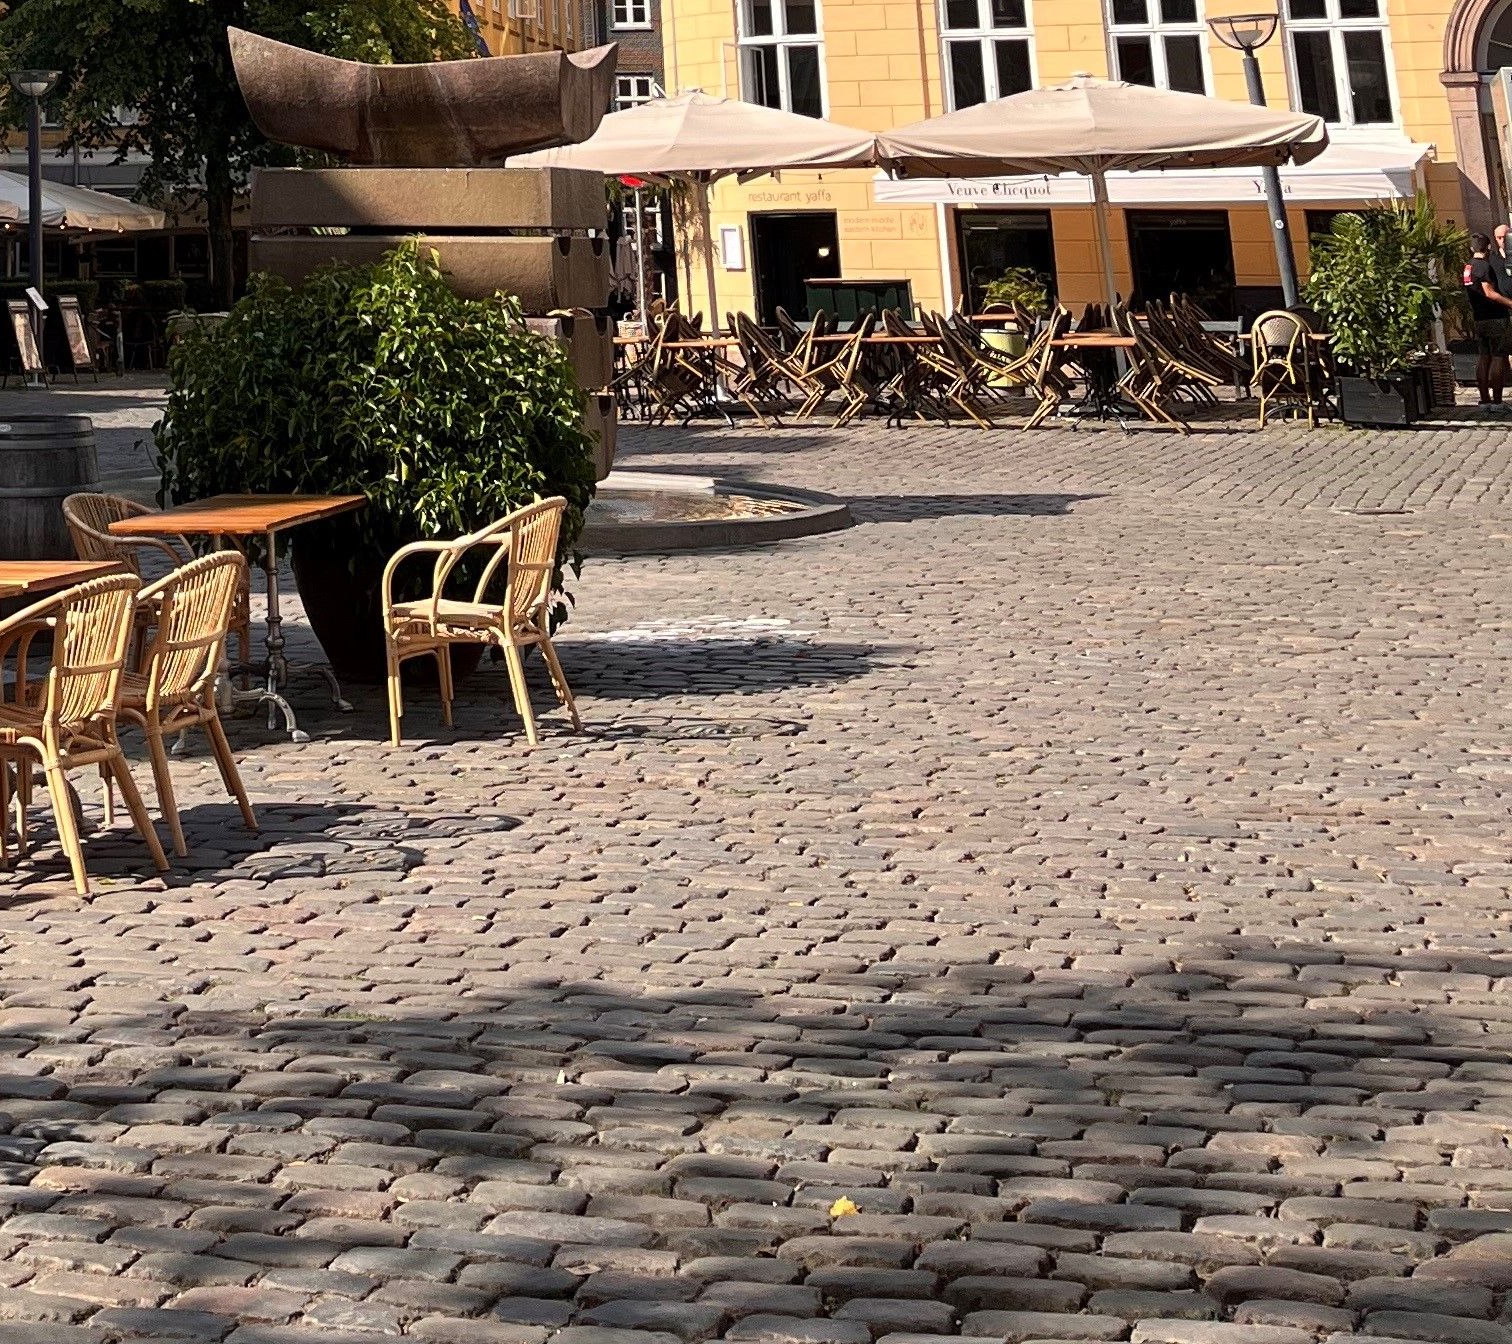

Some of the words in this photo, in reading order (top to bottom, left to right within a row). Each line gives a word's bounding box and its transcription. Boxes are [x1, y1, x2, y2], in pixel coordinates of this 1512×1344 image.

[947, 182, 988, 196] Veuve
[748, 190, 801, 202] restaurant
[806, 189, 832, 204] yaffa
